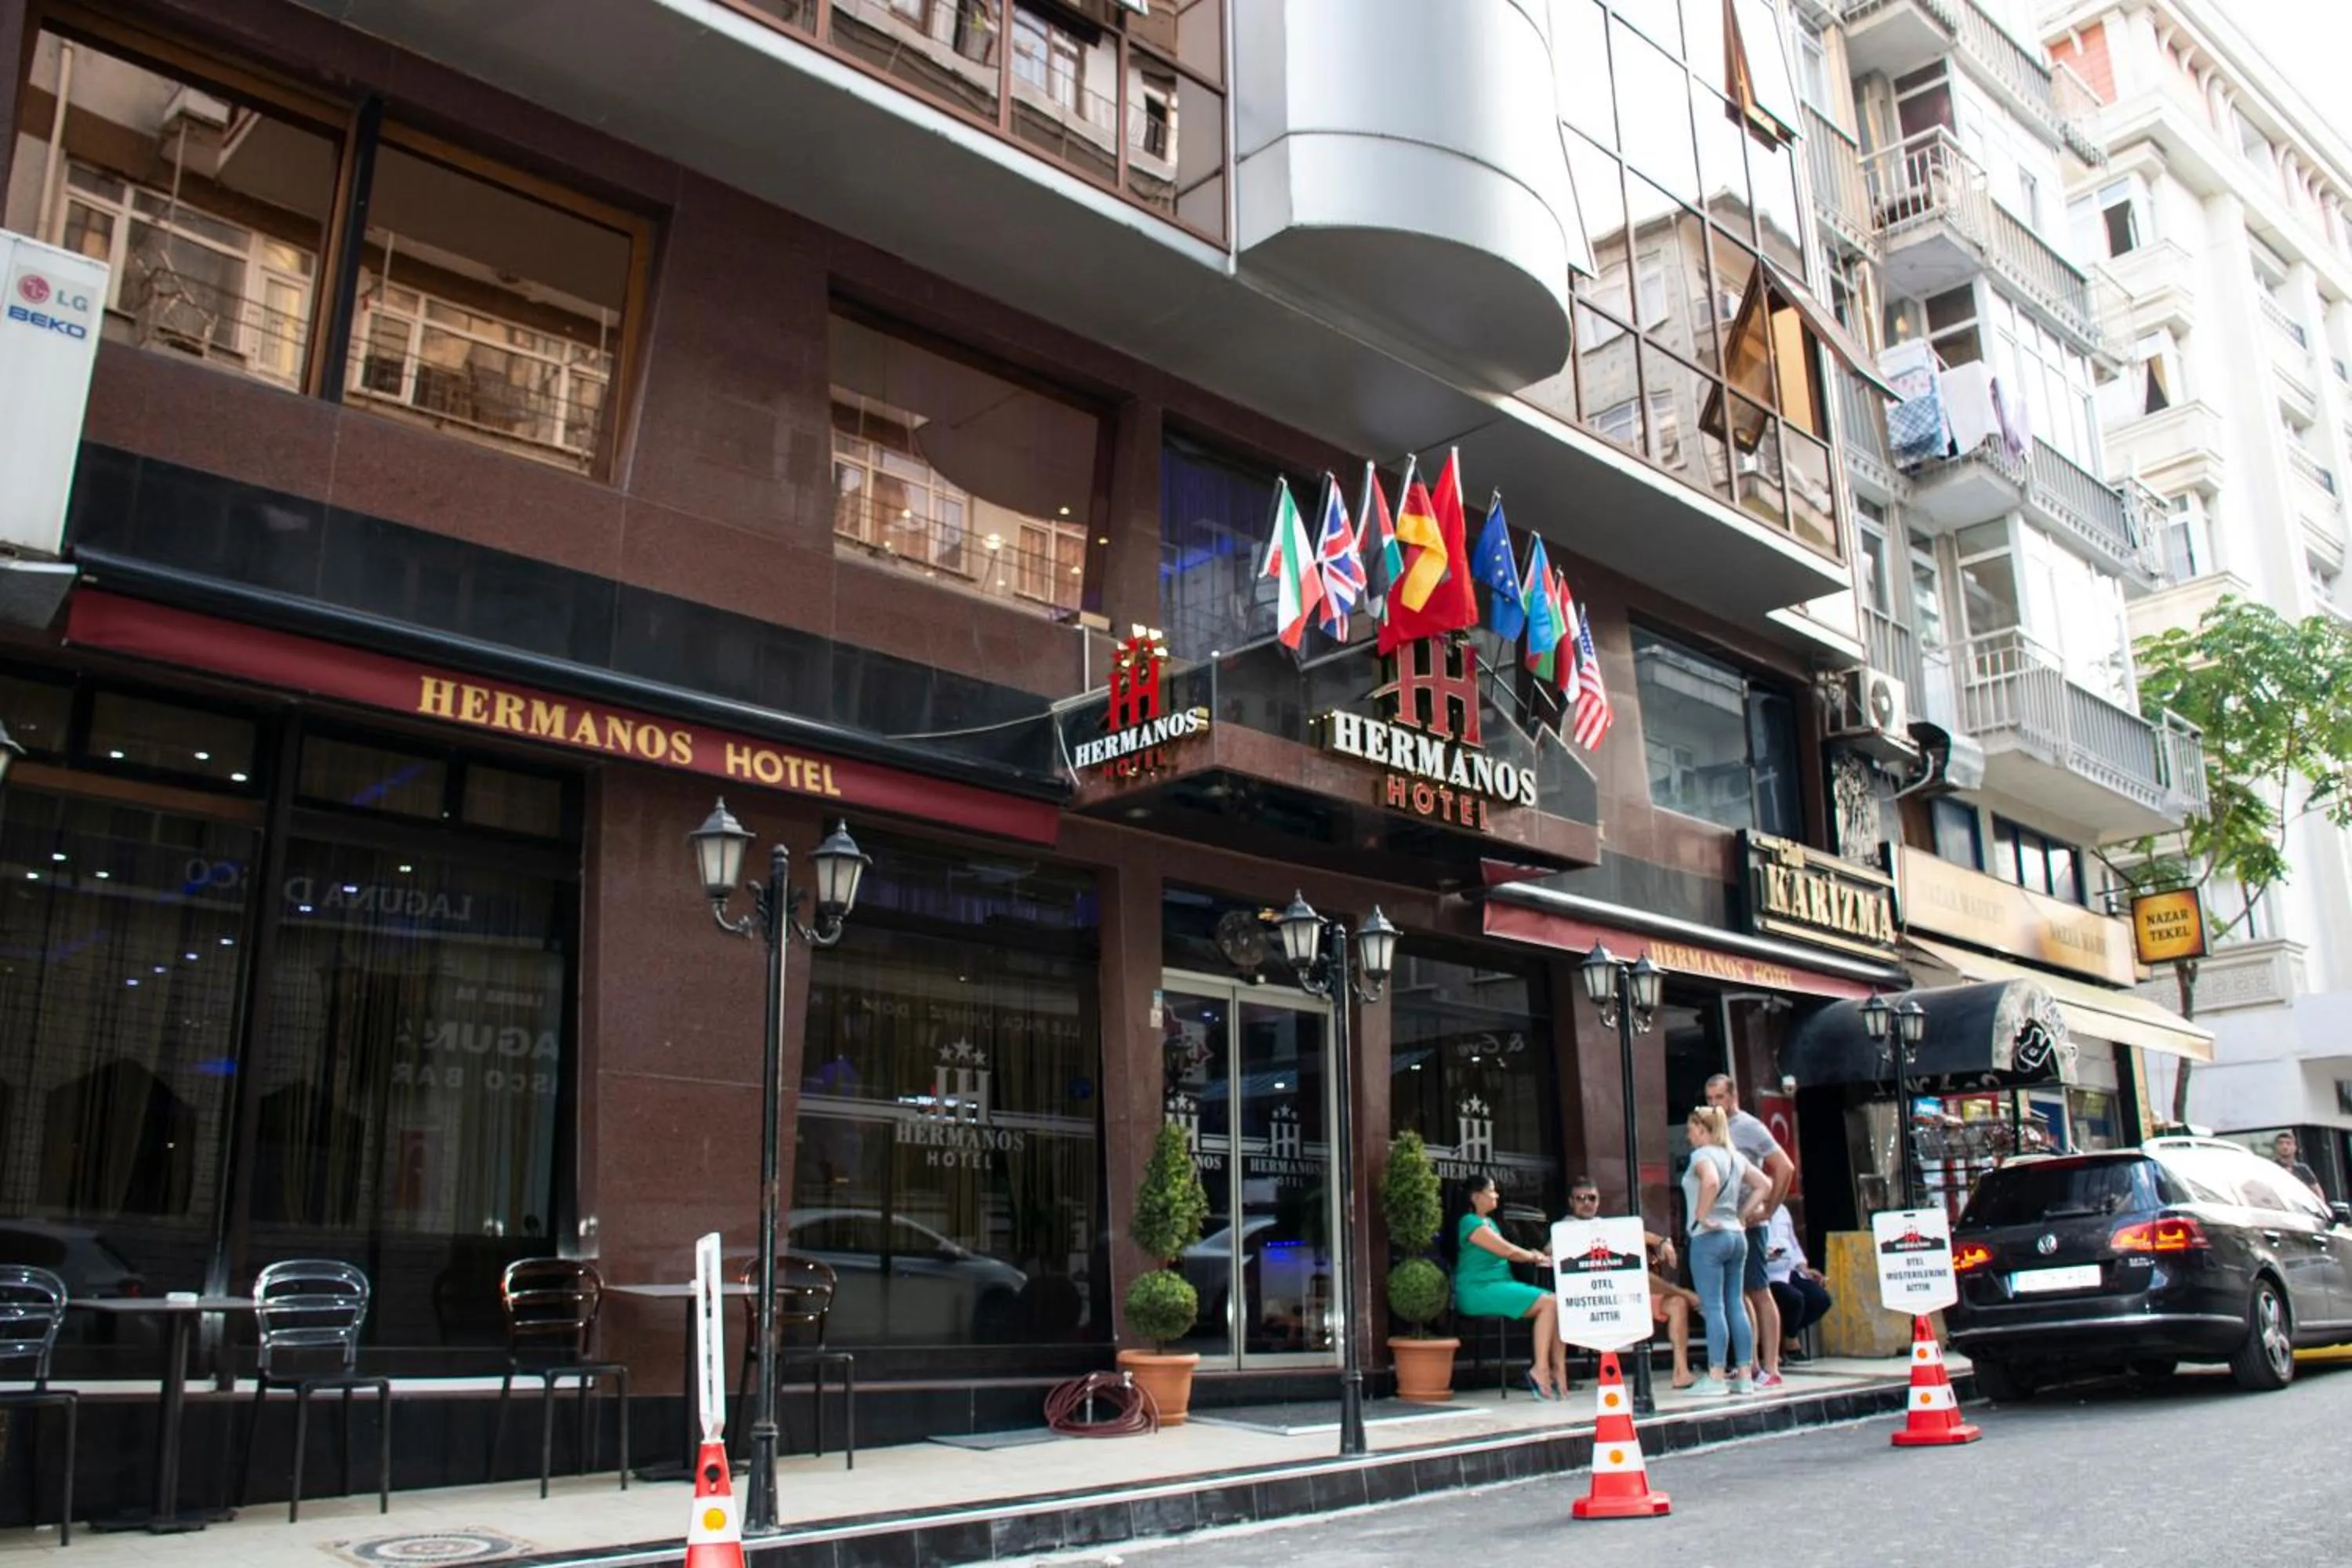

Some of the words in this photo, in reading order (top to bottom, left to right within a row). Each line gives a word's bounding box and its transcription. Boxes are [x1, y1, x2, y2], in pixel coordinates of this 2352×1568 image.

[56, 289, 89, 312] LG
[8, 304, 87, 339] BEKO
[417, 675, 694, 766] HERMANOS
[724, 742, 841, 797] HOTEL
[1074, 706, 1200, 769] HERMANOS
[1332, 709, 1537, 807] HERMANOS
[1386, 773, 1494, 833] HOTEL
[2147, 909, 2189, 925] NAZAR
[2149, 925, 2191, 942] TEKEL
[1650, 941, 1747, 979] HERMANOS
[895, 1120, 1025, 1152] HERMANOS
[926, 1150, 993, 1171] HOTEL
[1250, 1156, 1323, 1175] HERMANOS
[1437, 1160, 1517, 1183] HERMANOS
[1590, 1279, 1614, 1290] OTEL
